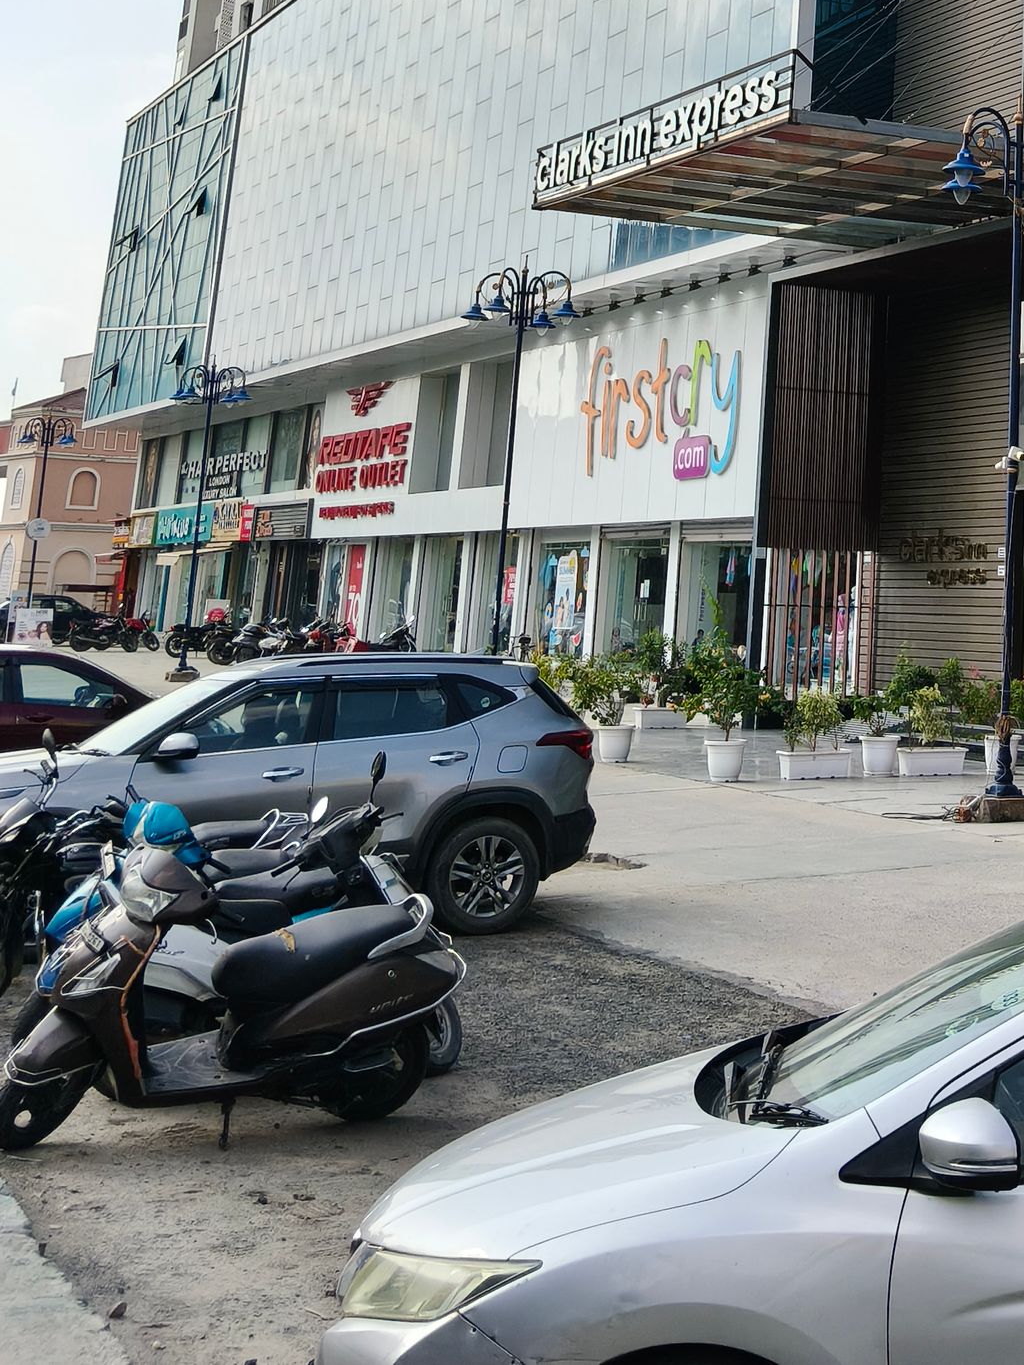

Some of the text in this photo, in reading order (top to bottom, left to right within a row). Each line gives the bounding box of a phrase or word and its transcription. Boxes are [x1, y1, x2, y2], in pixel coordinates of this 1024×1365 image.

[611, 118, 652, 165] inn
[659, 70, 777, 151] express
[581, 338, 742, 477] firstcry
[317, 422, 412, 466] REDTAPE
[675, 446, 704, 470] .com
[187, 457, 215, 478] HAR
[215, 450, 269, 475] PERFECT
[209, 474, 231, 487] LONDON
[315, 459, 408, 494] ONLINE OUTLET
